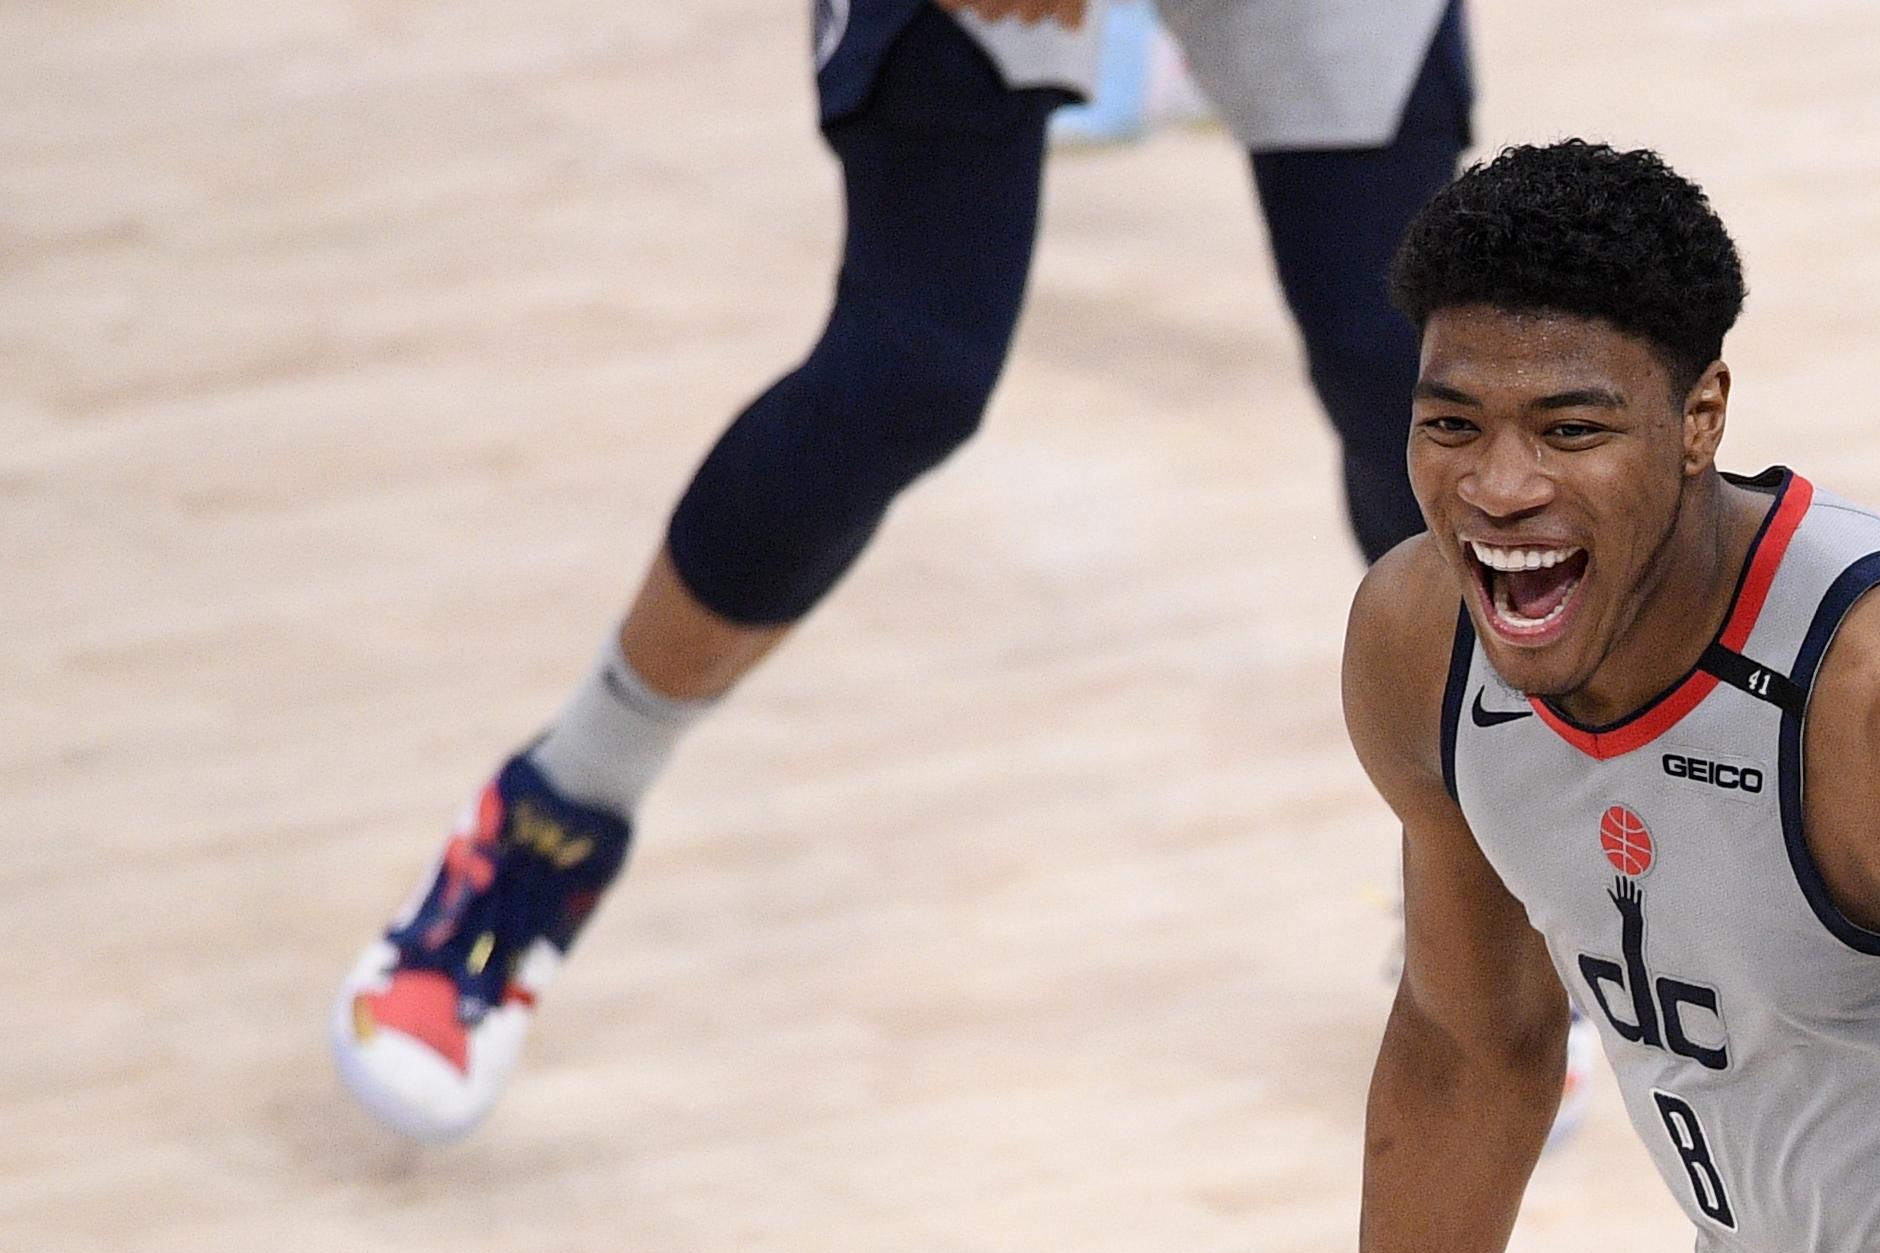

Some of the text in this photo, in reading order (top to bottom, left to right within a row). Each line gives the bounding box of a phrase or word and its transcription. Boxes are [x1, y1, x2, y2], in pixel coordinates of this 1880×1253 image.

[1748, 669, 1771, 695] 41
[1662, 753, 1763, 794] GEICO
[1578, 876, 1728, 1070] dc
[1652, 1089, 1737, 1231] 8
